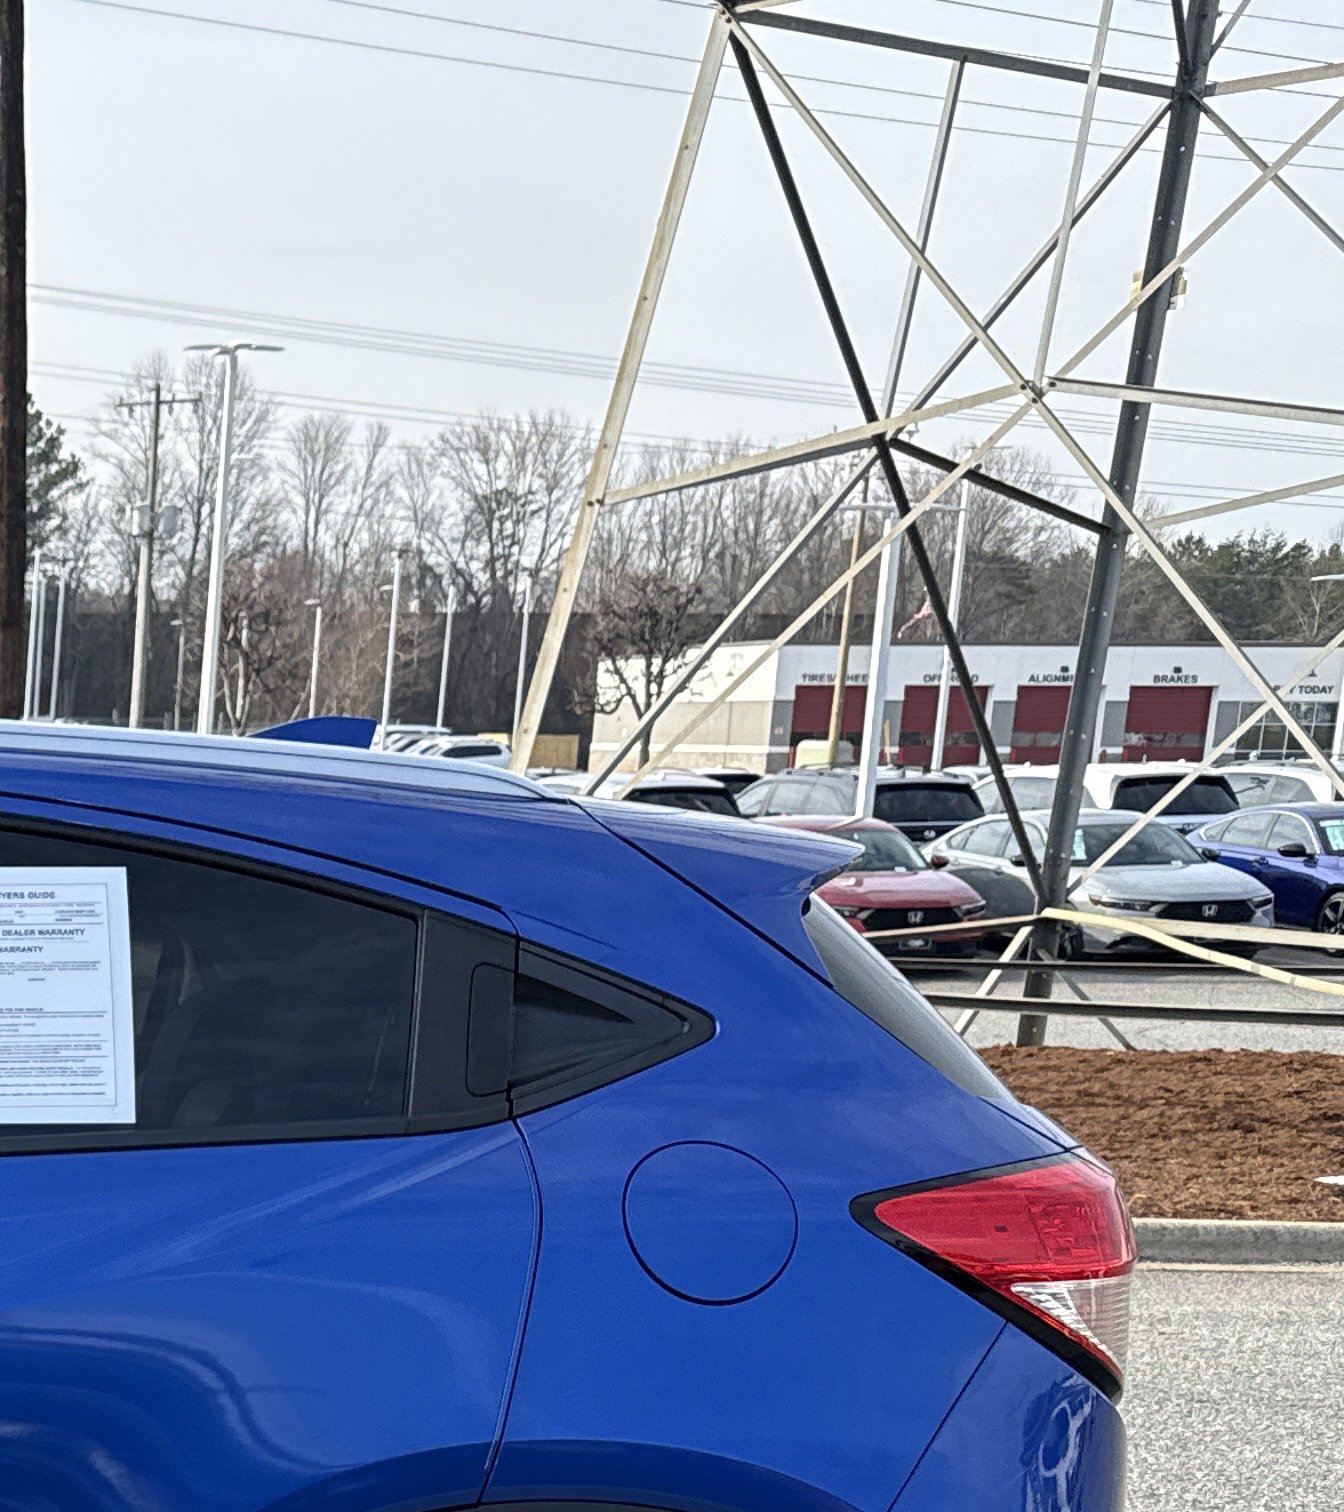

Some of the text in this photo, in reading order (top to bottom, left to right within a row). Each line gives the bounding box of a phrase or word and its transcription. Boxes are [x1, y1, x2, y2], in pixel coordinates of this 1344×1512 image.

[1027, 674, 1075, 683] ALIGNM
[1152, 674, 1199, 684] BRAKES
[1298, 685, 1335, 694] TODAY
[1, 929, 36, 937] DEALER
